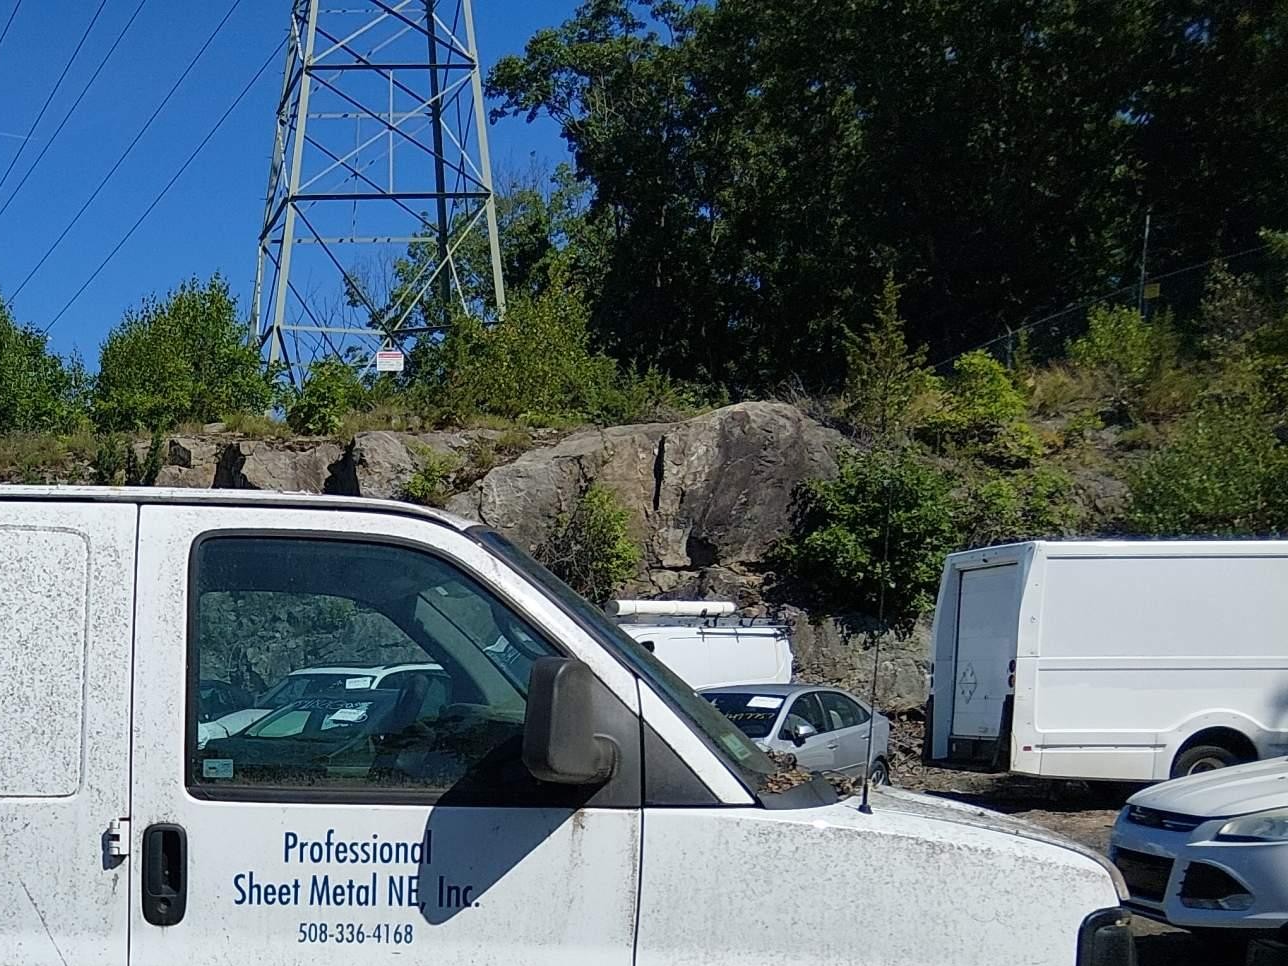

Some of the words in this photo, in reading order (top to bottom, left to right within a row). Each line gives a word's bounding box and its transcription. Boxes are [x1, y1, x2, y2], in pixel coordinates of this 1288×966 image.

[284, 829, 432, 864] Professional
[233, 871, 300, 905] Sheet
[310, 872, 378, 907] Metal
[388, 875, 426, 914] NE,
[438, 876, 481, 908] Inc.
[298, 922, 414, 944] 508-336-4168
